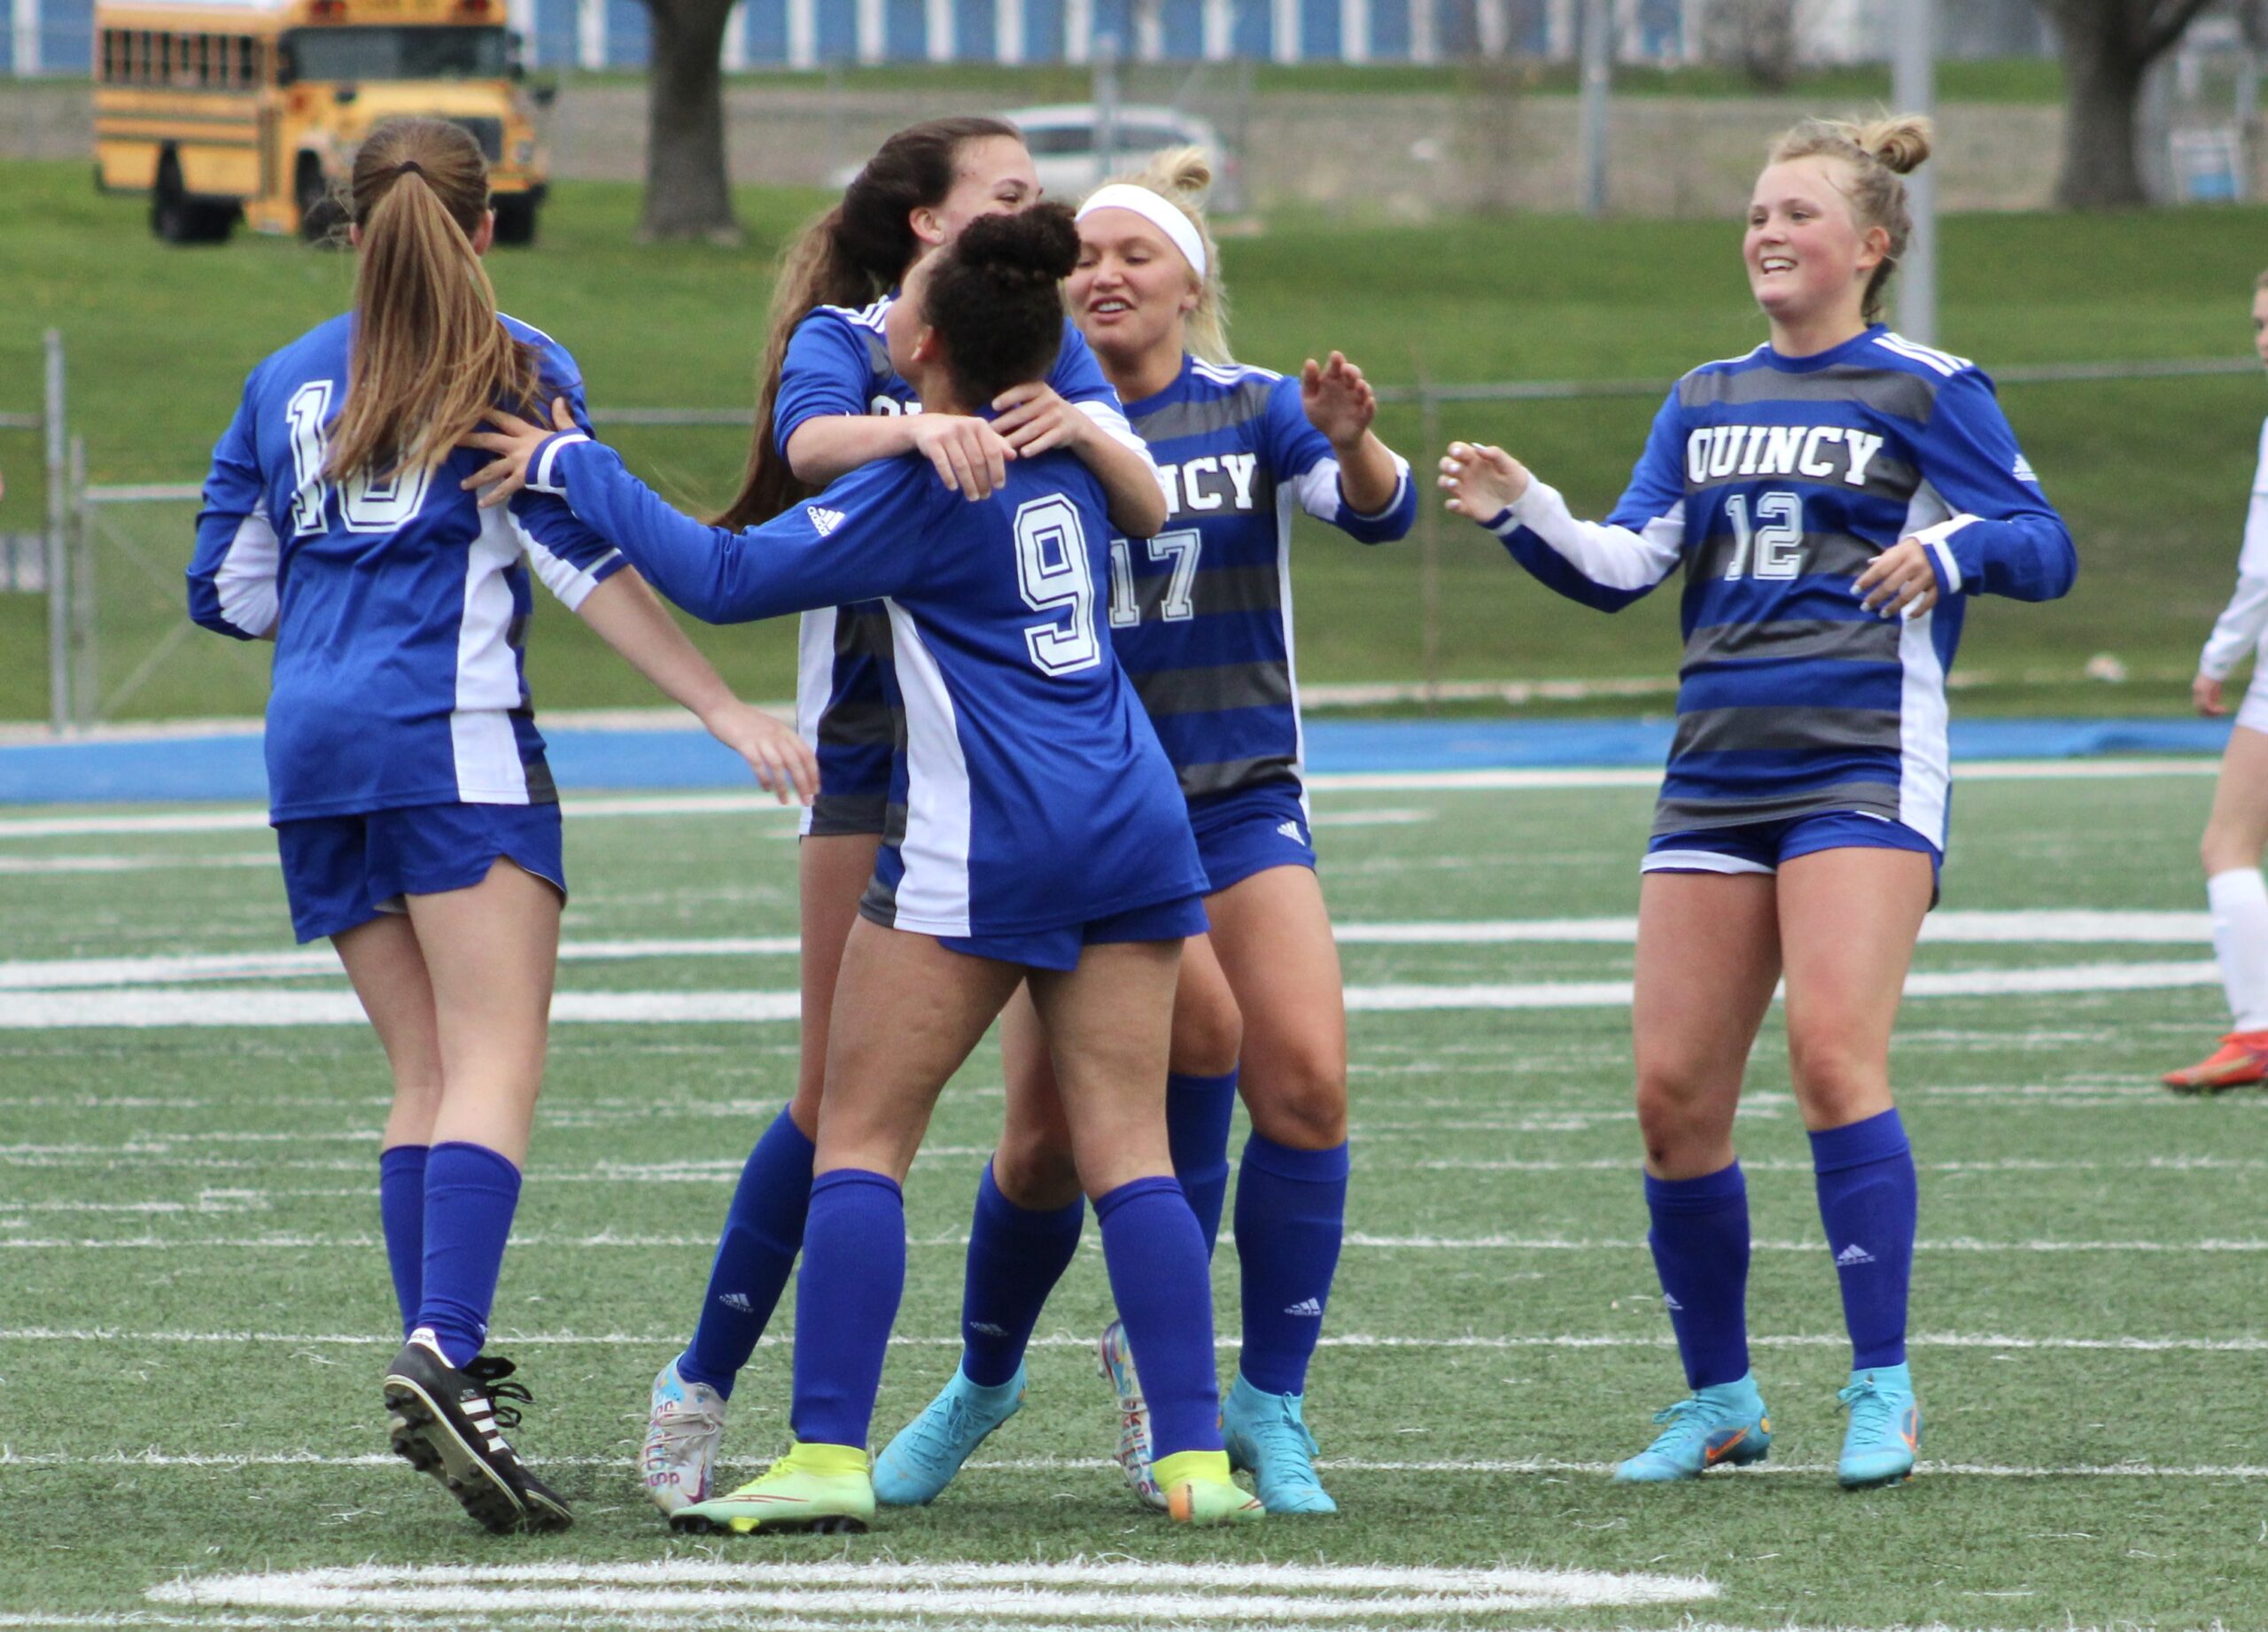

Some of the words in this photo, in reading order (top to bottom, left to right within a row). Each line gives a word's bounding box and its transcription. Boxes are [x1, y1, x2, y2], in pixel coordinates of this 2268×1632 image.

[1687, 425, 1884, 486] QUINCY
[1108, 528, 1201, 629] 17
[1724, 492, 1806, 581] 12
[1013, 493, 1100, 677] 9
